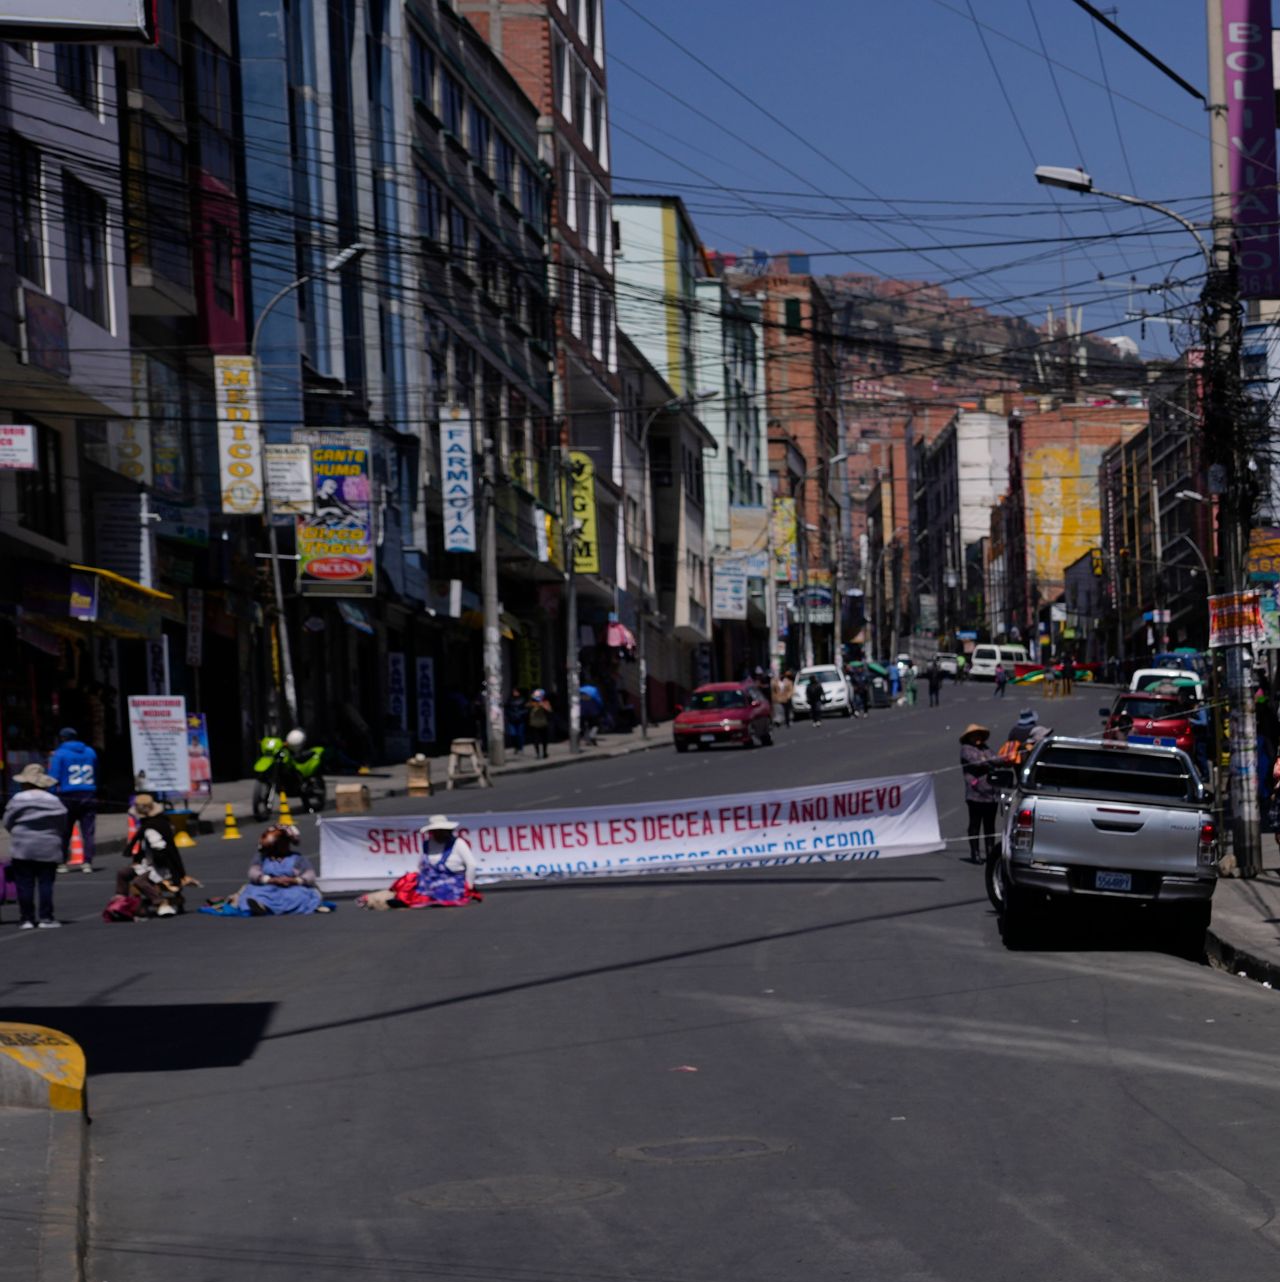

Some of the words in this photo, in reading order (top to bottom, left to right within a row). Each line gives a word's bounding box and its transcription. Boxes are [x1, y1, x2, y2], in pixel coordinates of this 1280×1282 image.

[1226, 22, 1273, 272] BOLIVIANO
[446, 429, 470, 536] FARMACIA
[67, 763, 95, 786] 22
[368, 827, 473, 855] SEÑS
[479, 822, 589, 853] CLIENTES
[595, 817, 638, 847] LES
[643, 810, 714, 843] DECEA
[719, 802, 783, 834] FELIZ
[788, 796, 829, 825] AÑO
[833, 785, 902, 818] NUEVO
